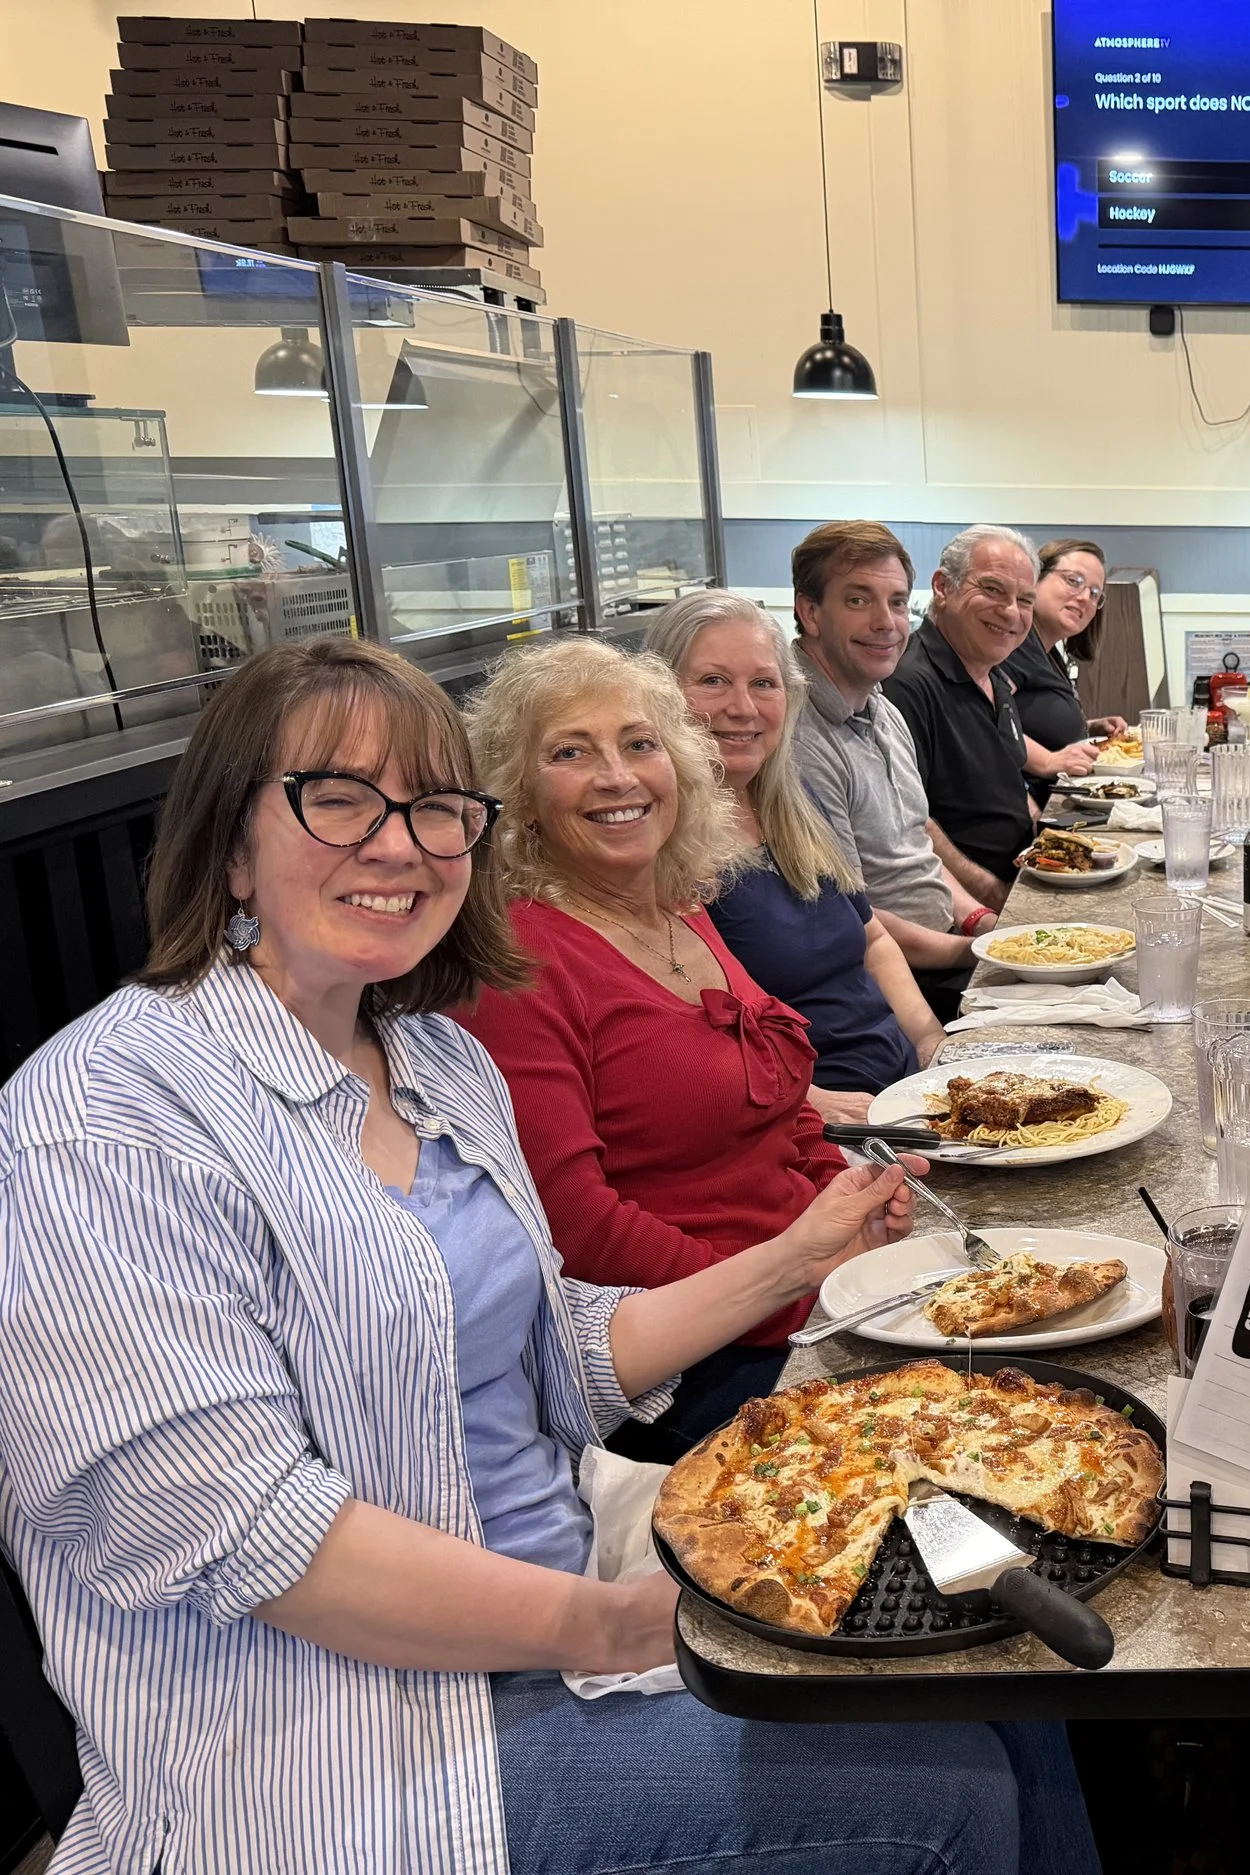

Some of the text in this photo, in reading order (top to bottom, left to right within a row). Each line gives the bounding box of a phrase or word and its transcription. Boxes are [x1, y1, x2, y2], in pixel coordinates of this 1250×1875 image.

[1095, 73, 1161, 84] Question 2 of 10
[1095, 93, 1143, 110] Which
[1146, 94, 1187, 114] sport
[1189, 94, 1228, 111] does
[1109, 171, 1152, 184] Soccer
[1109, 206, 1156, 223] Hockey
[1097, 263, 1133, 274] Location
[1134, 264, 1157, 274] Code
